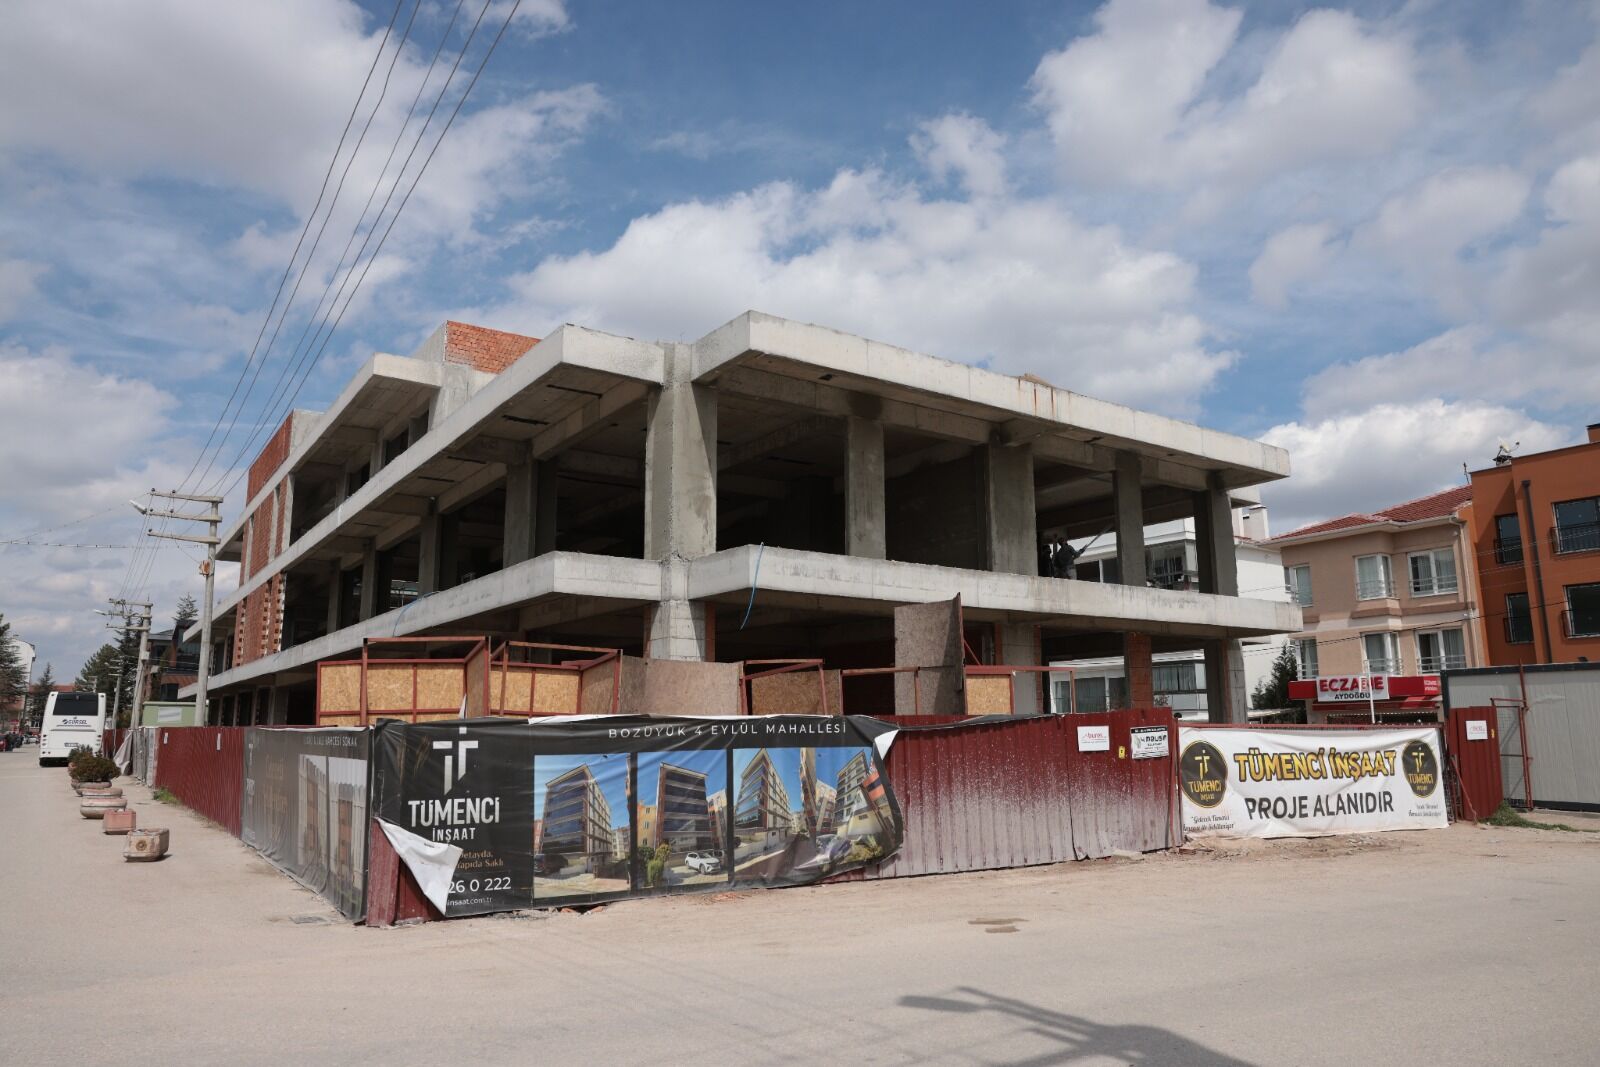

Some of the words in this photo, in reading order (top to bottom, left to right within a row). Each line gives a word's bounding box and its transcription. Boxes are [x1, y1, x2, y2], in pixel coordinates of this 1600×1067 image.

[608, 725, 686, 738] BOZÜYÜK
[695, 726, 702, 735] 4
[711, 721, 758, 735] EYLÜL
[766, 721, 846, 734] MAHALLESİ
[1233, 747, 1328, 782] TÜMENCİ
[1328, 747, 1396, 782] İNŞAAT
[408, 797, 500, 828] TÜMENCİ
[1244, 796, 1308, 820] PROJE
[1313, 790, 1394, 817] ALANIDIR
[432, 828, 476, 843] İNŞAAT
[449, 880, 465, 894] 26
[469, 879, 480, 892] 0
[484, 877, 512, 891] 222
